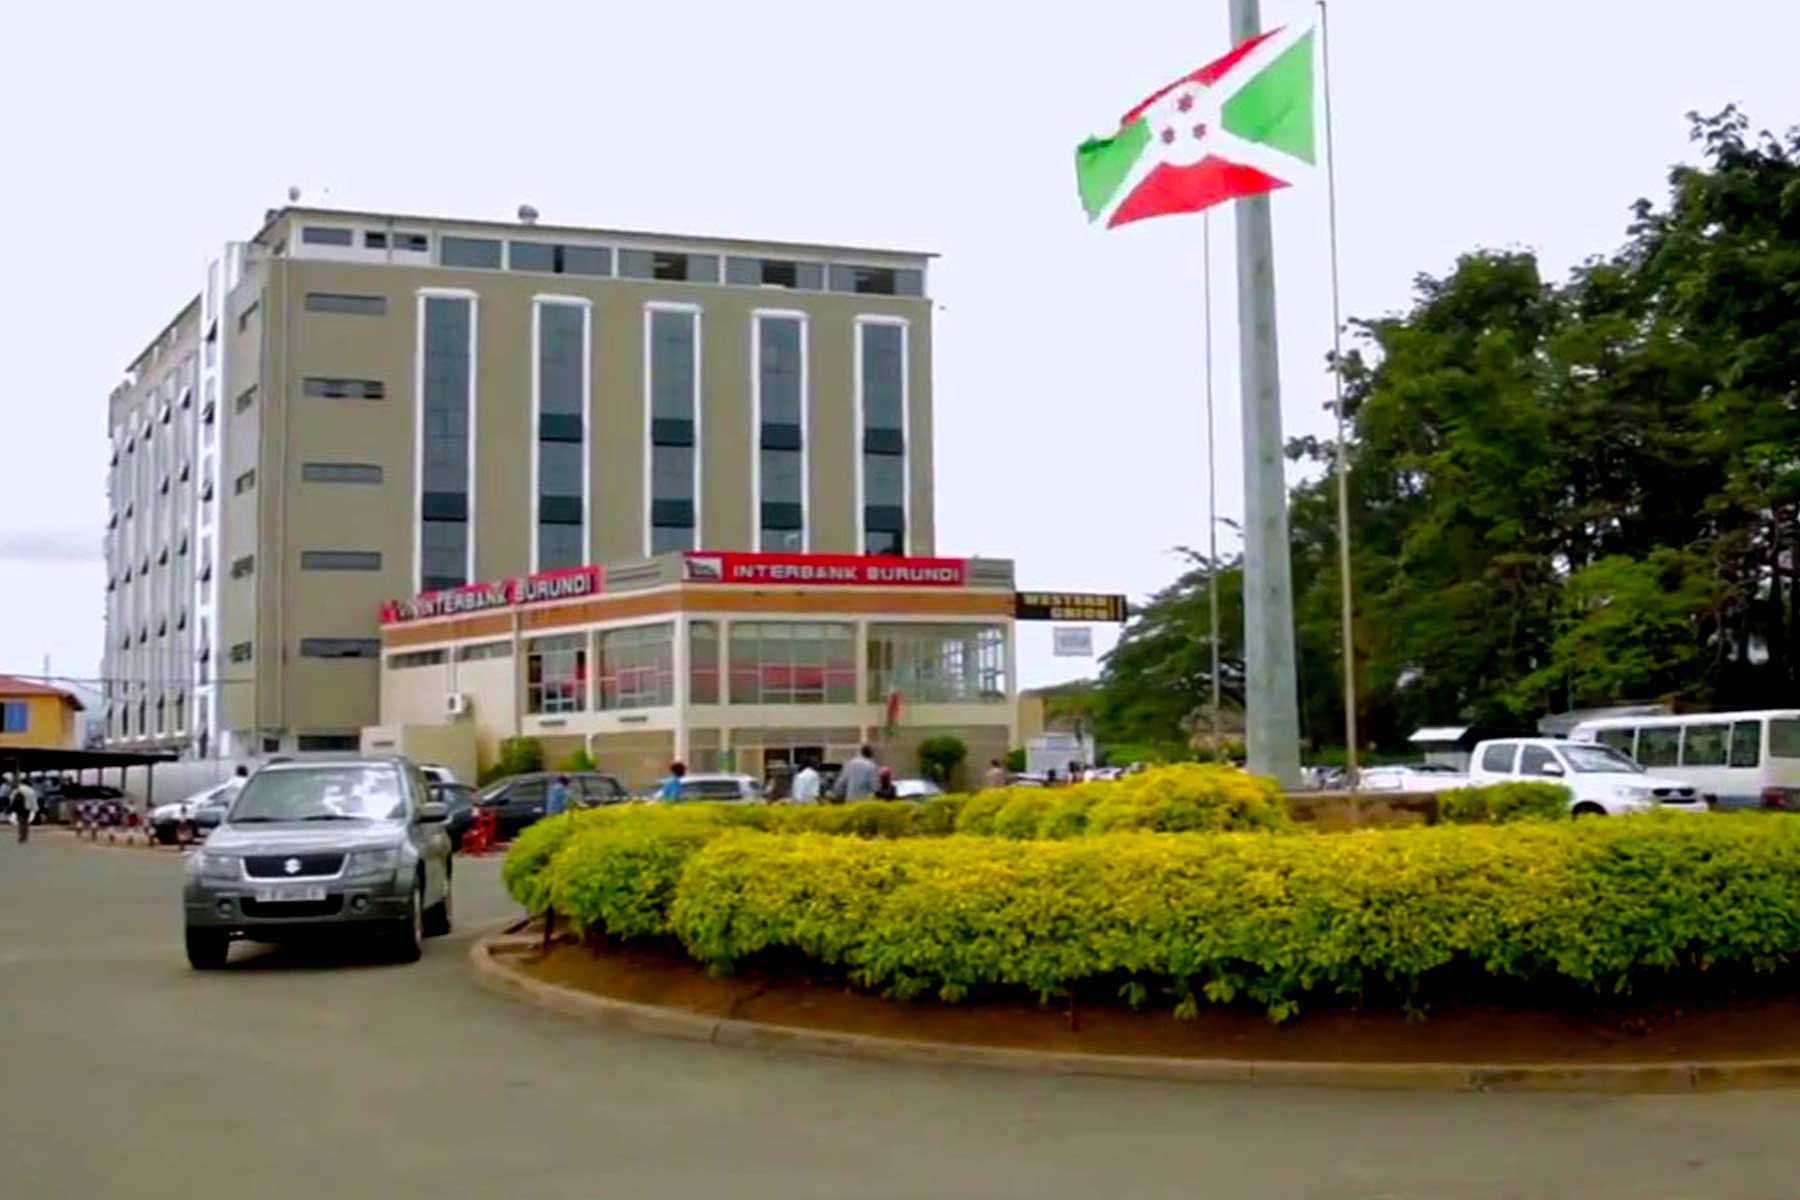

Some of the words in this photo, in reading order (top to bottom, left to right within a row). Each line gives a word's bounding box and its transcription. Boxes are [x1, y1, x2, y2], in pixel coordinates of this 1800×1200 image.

[733, 564, 858, 580] INTERBANK
[866, 567, 960, 582] BURUNDI
[514, 574, 592, 603] BURUNDI
[1023, 594, 1108, 607] WESTERN
